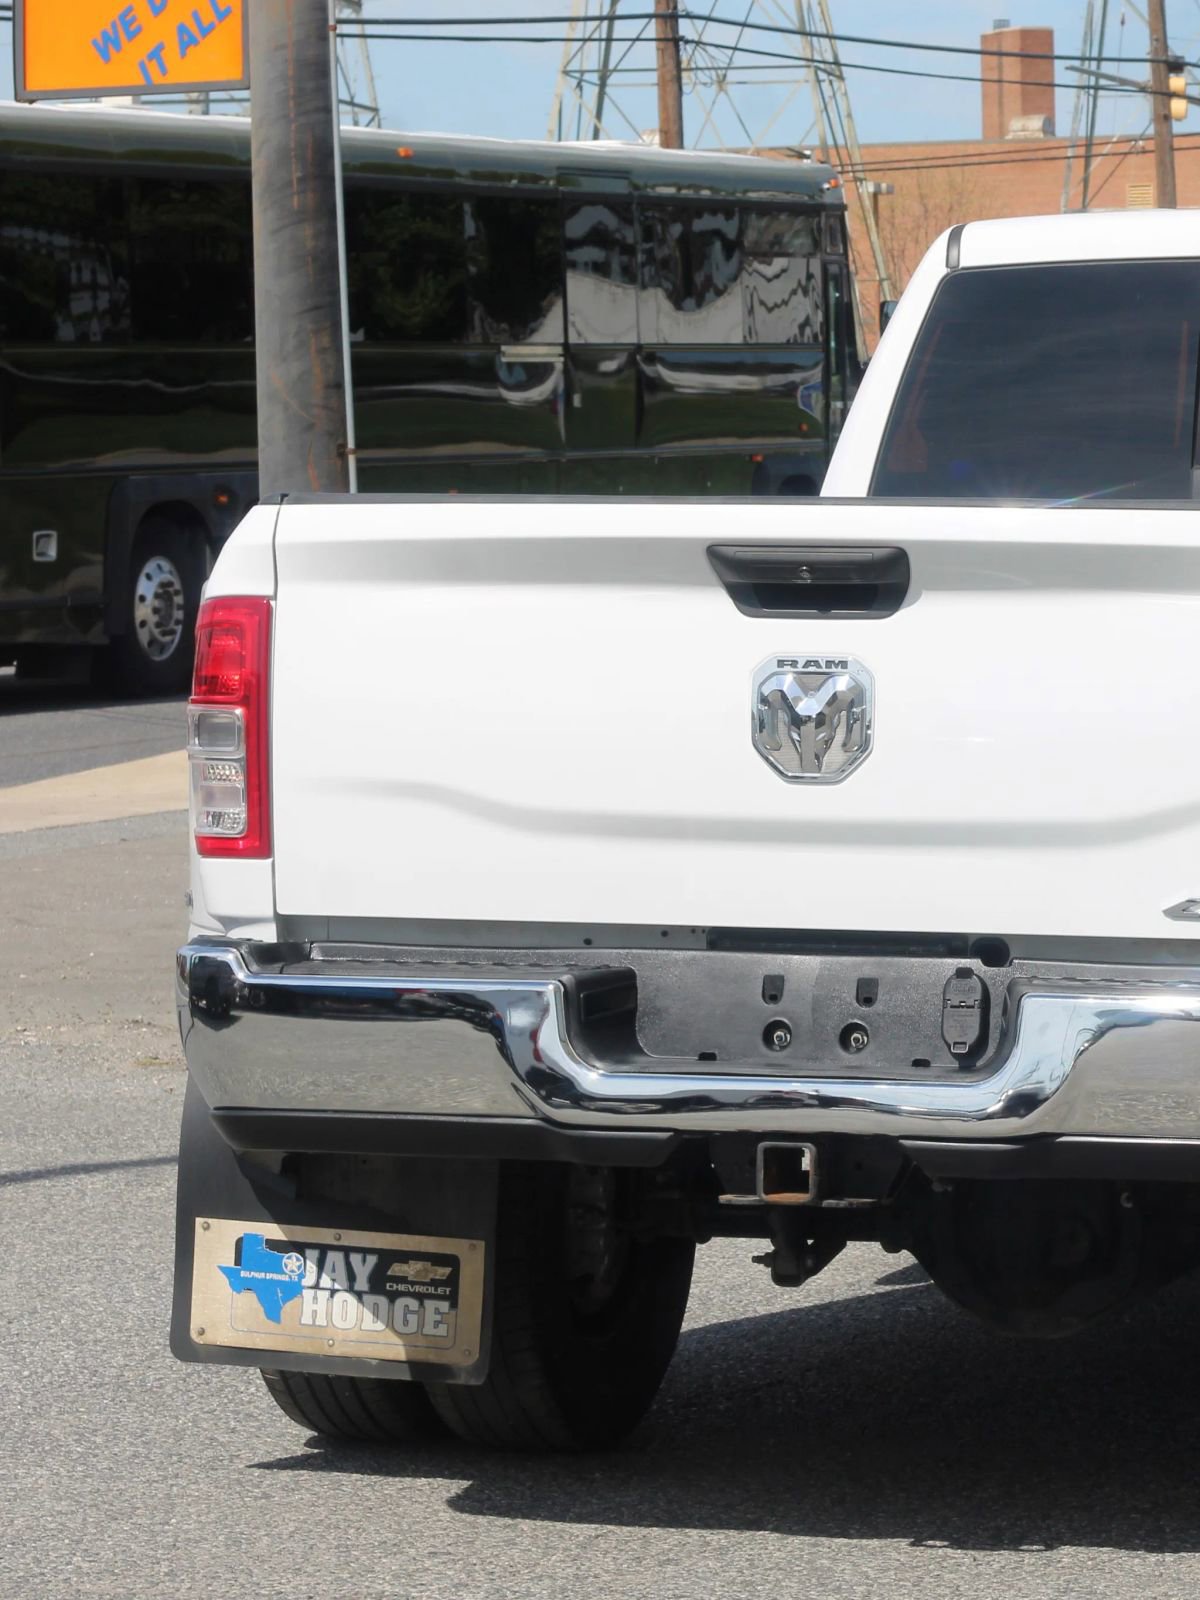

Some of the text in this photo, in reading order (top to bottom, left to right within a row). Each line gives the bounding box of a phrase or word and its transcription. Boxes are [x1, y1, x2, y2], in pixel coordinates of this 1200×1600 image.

[91, 4, 142, 64] WE
[138, 0, 232, 86] IT ALL
[776, 659, 848, 670] RAM
[301, 1248, 379, 1291] JAY
[386, 1282, 452, 1295] CHEVROLET
[300, 1288, 450, 1337] HODGE
